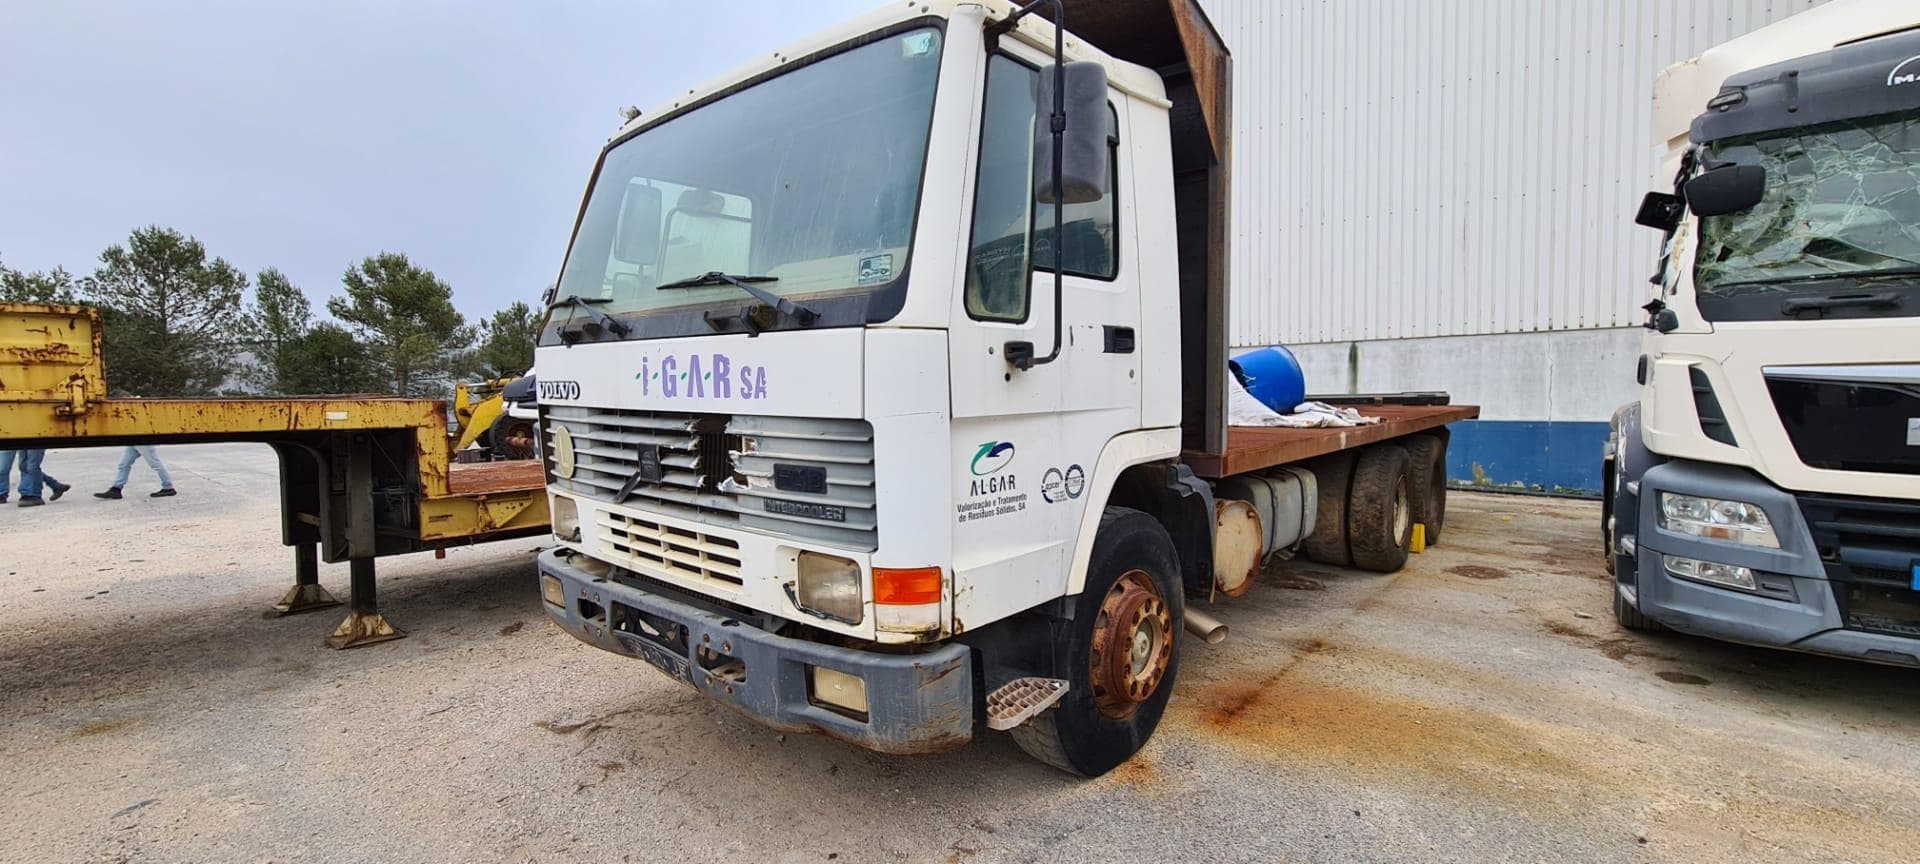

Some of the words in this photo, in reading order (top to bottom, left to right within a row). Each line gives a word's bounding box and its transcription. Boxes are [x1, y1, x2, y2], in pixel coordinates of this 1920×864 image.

[1894, 74, 1920, 85] M
[538, 380, 581, 400] VOLVO
[740, 365, 768, 400] SA
[970, 474, 1016, 497] ALGAR
[765, 497, 843, 521] INTERCOOLER
[957, 499, 992, 513] Valorização
[998, 492, 1027, 505] Tratamento
[959, 513, 967, 523] de
[968, 508, 995, 521] Resíduos
[1018, 502, 1026, 511] SA
